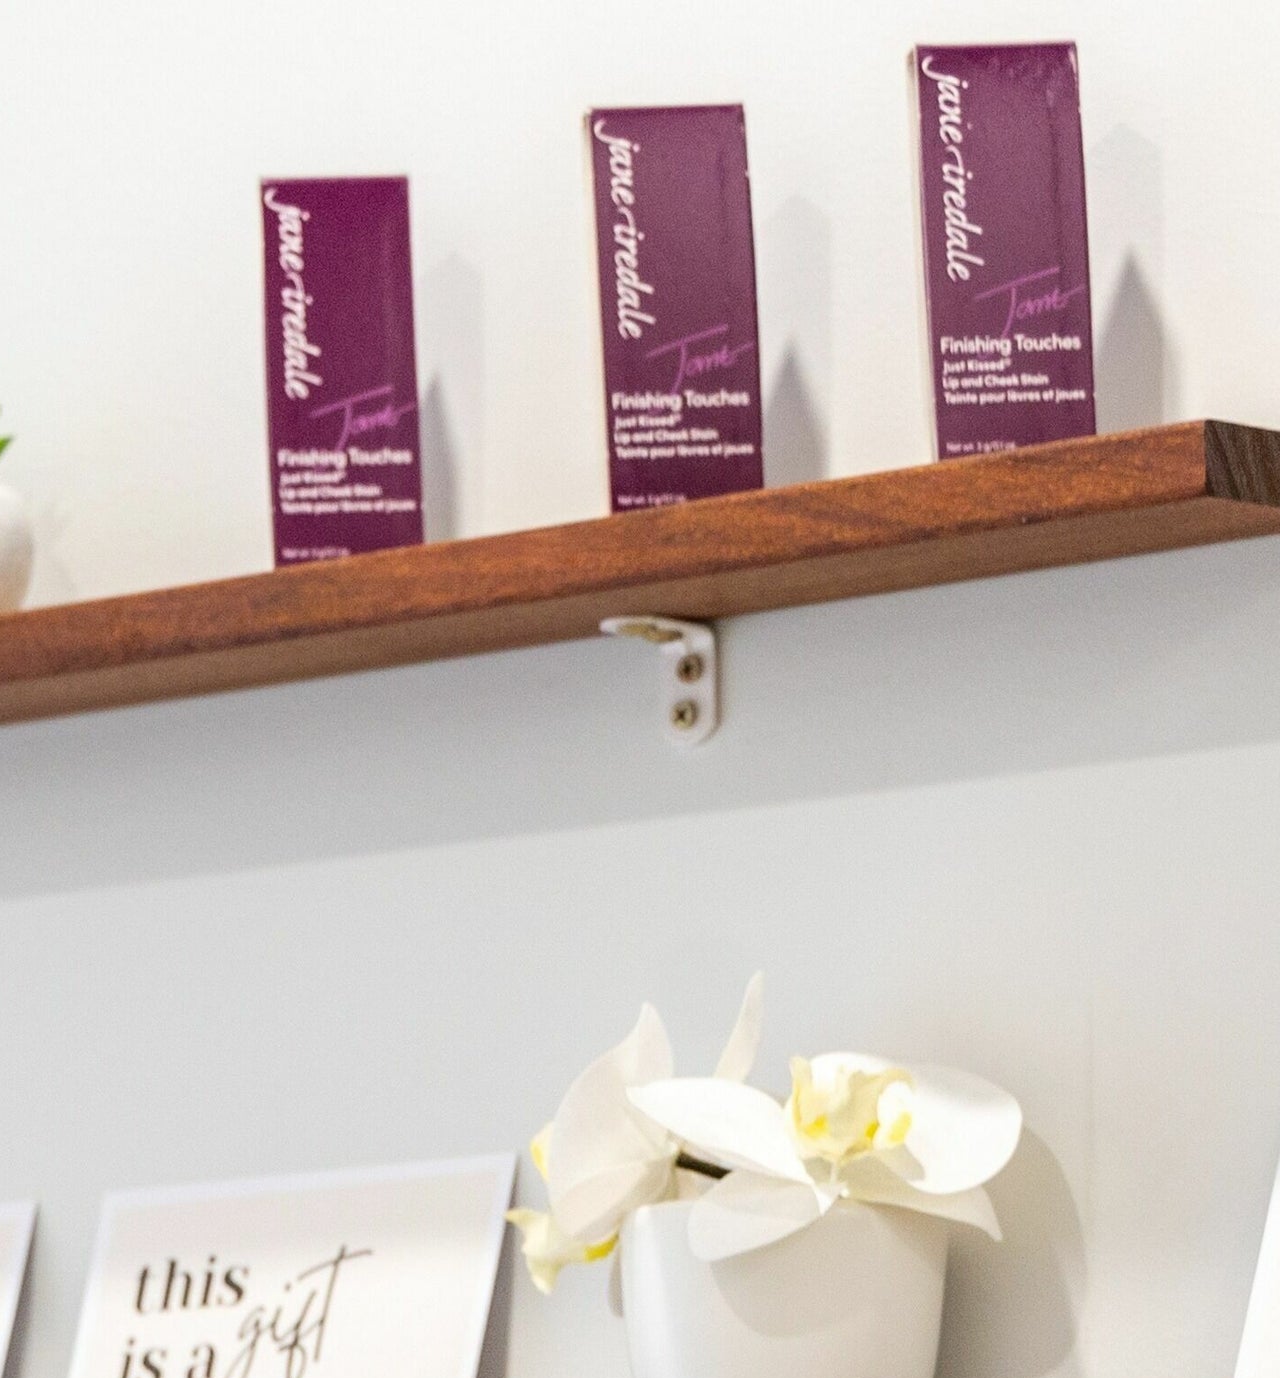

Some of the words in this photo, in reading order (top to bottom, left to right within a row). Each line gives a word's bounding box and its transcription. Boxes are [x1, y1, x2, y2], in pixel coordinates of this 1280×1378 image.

[921, 56, 970, 146] jane
[594, 118, 641, 206] jane
[942, 148, 984, 283] iredale
[614, 207, 657, 340] iredale
[939, 335, 1013, 357] Finishing
[1014, 332, 1082, 352] Touches
[610, 390, 682, 412] Finishing
[684, 389, 751, 408] Touches
[134, 1254, 251, 1316] this
